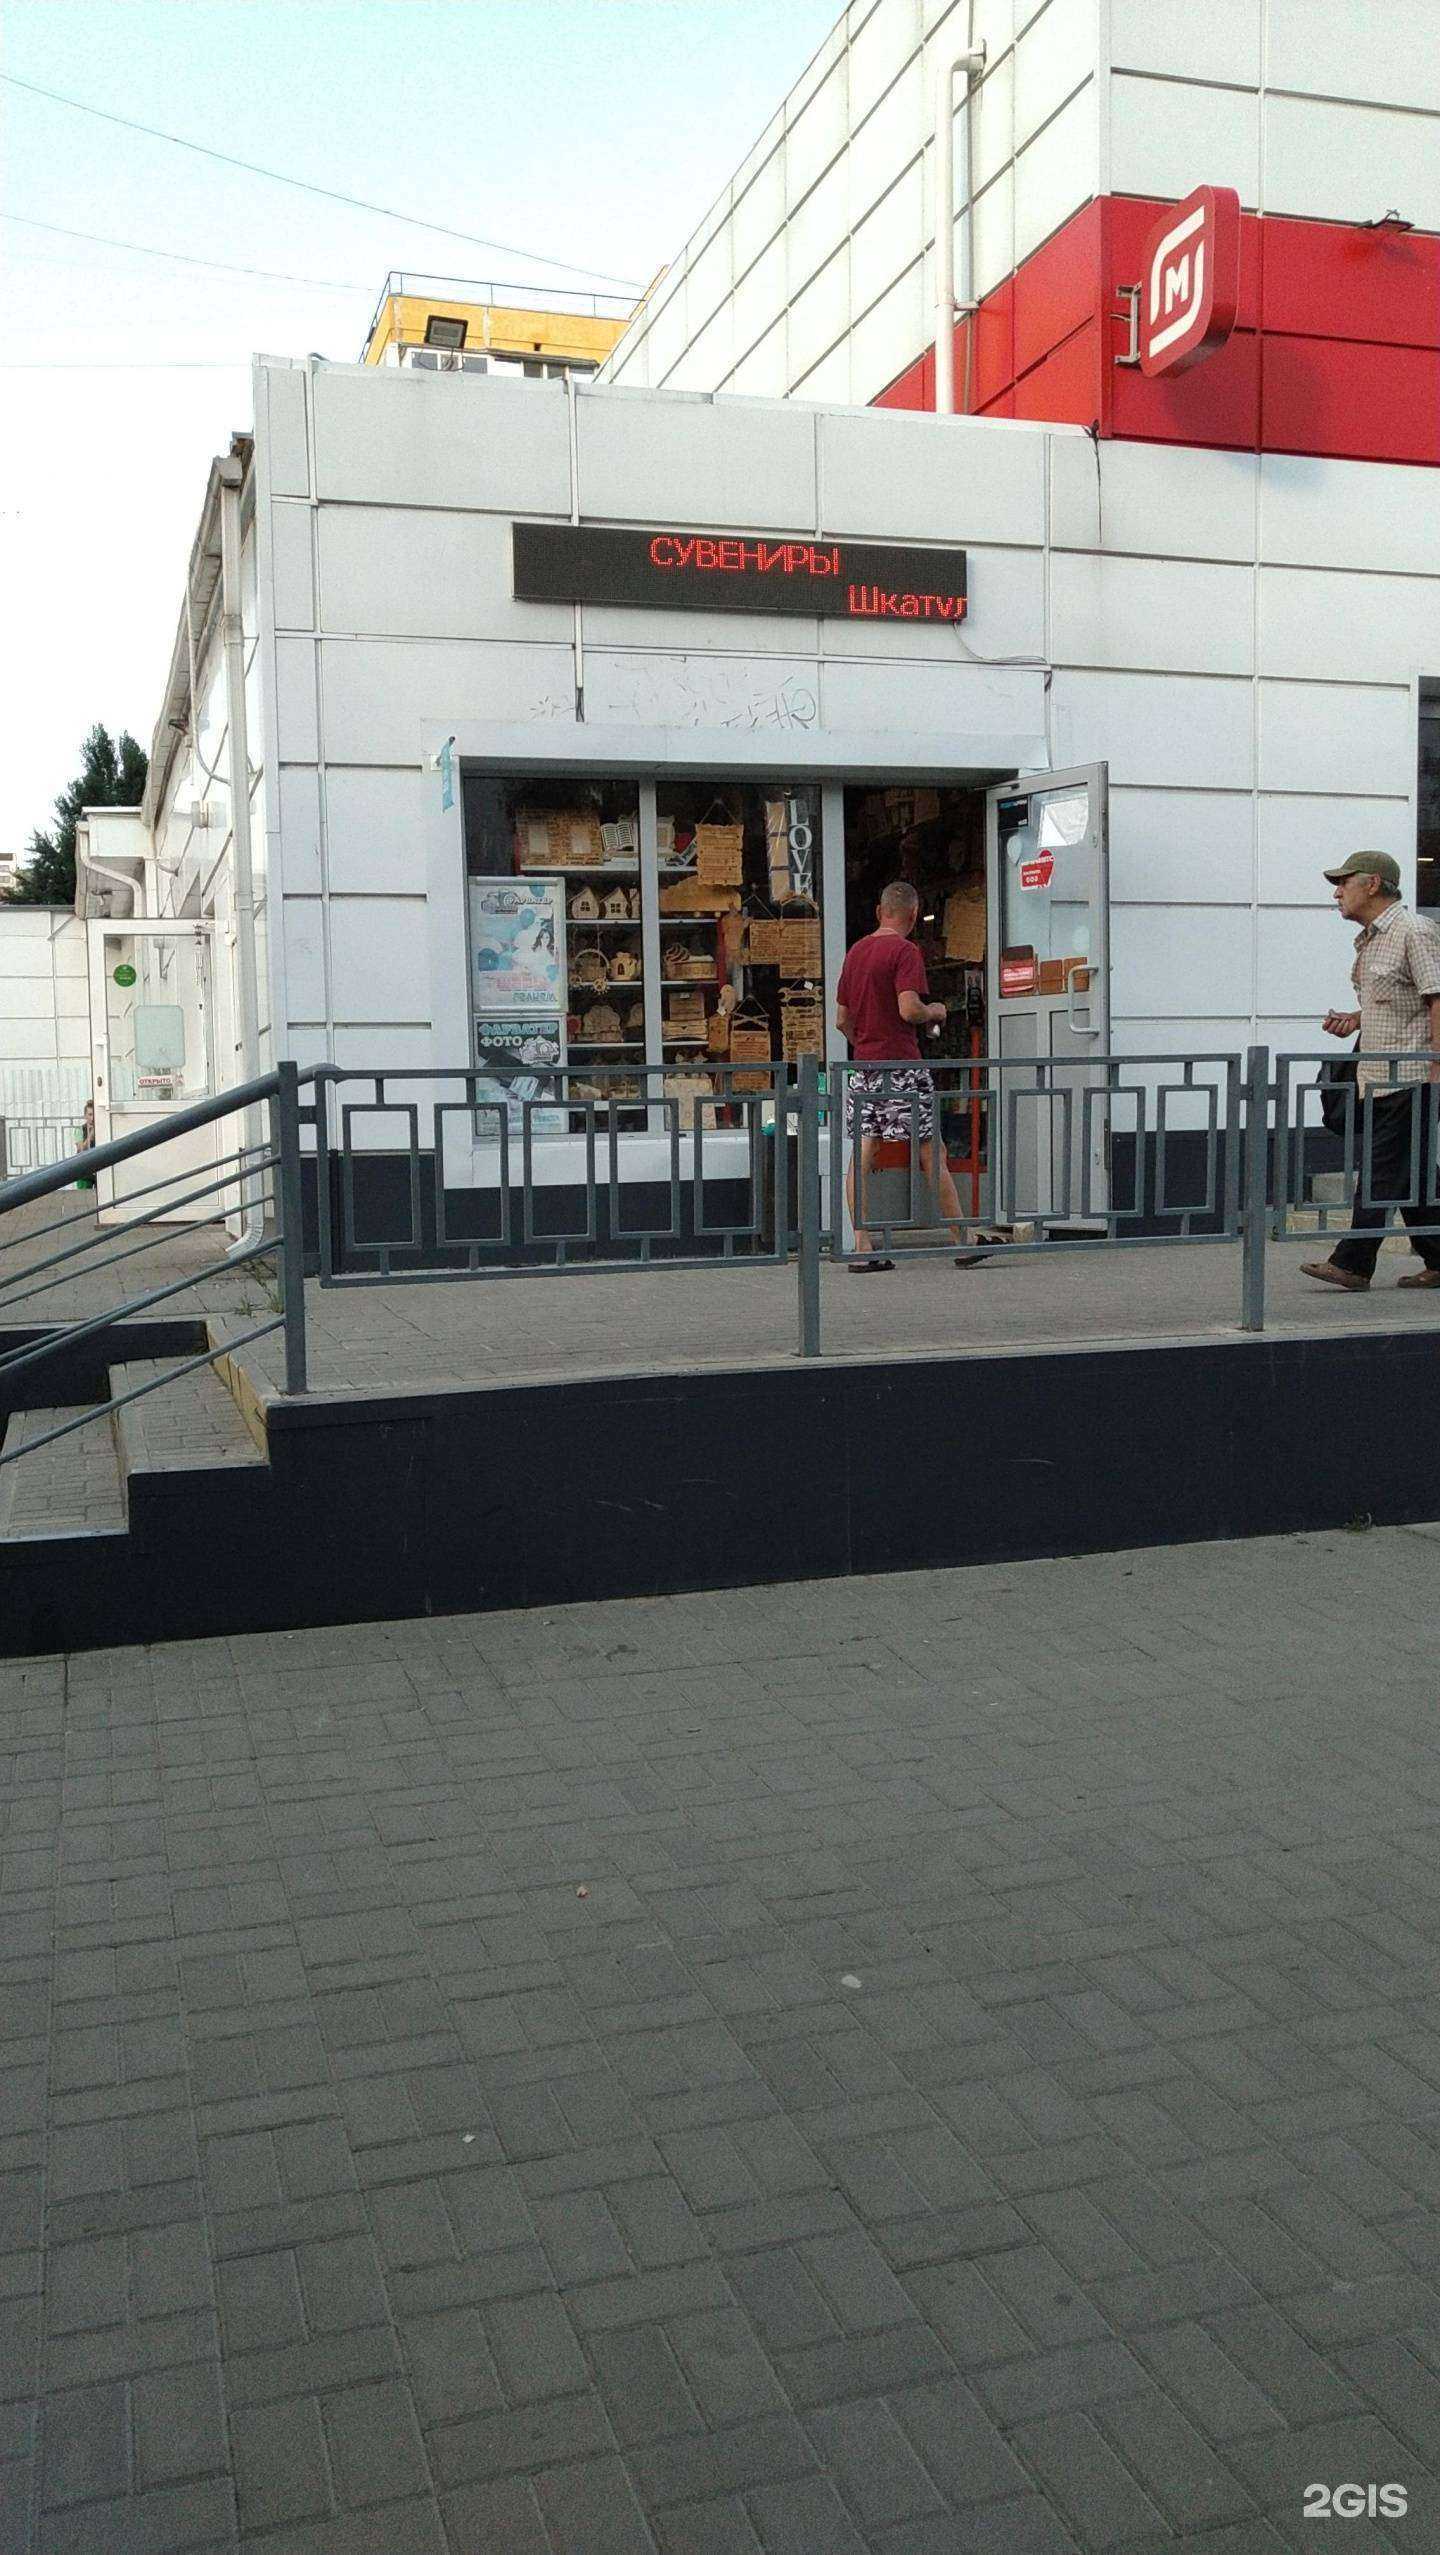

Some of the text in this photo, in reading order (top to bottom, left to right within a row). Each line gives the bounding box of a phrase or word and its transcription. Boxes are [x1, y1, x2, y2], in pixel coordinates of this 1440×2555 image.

[650, 536, 840, 576] СУВЕНИРЫ
[789, 799, 813, 898] LOVE
[480, 1035, 523, 1048] ФОТО
[138, 1077, 171, 1085] ОТКРЫТО
